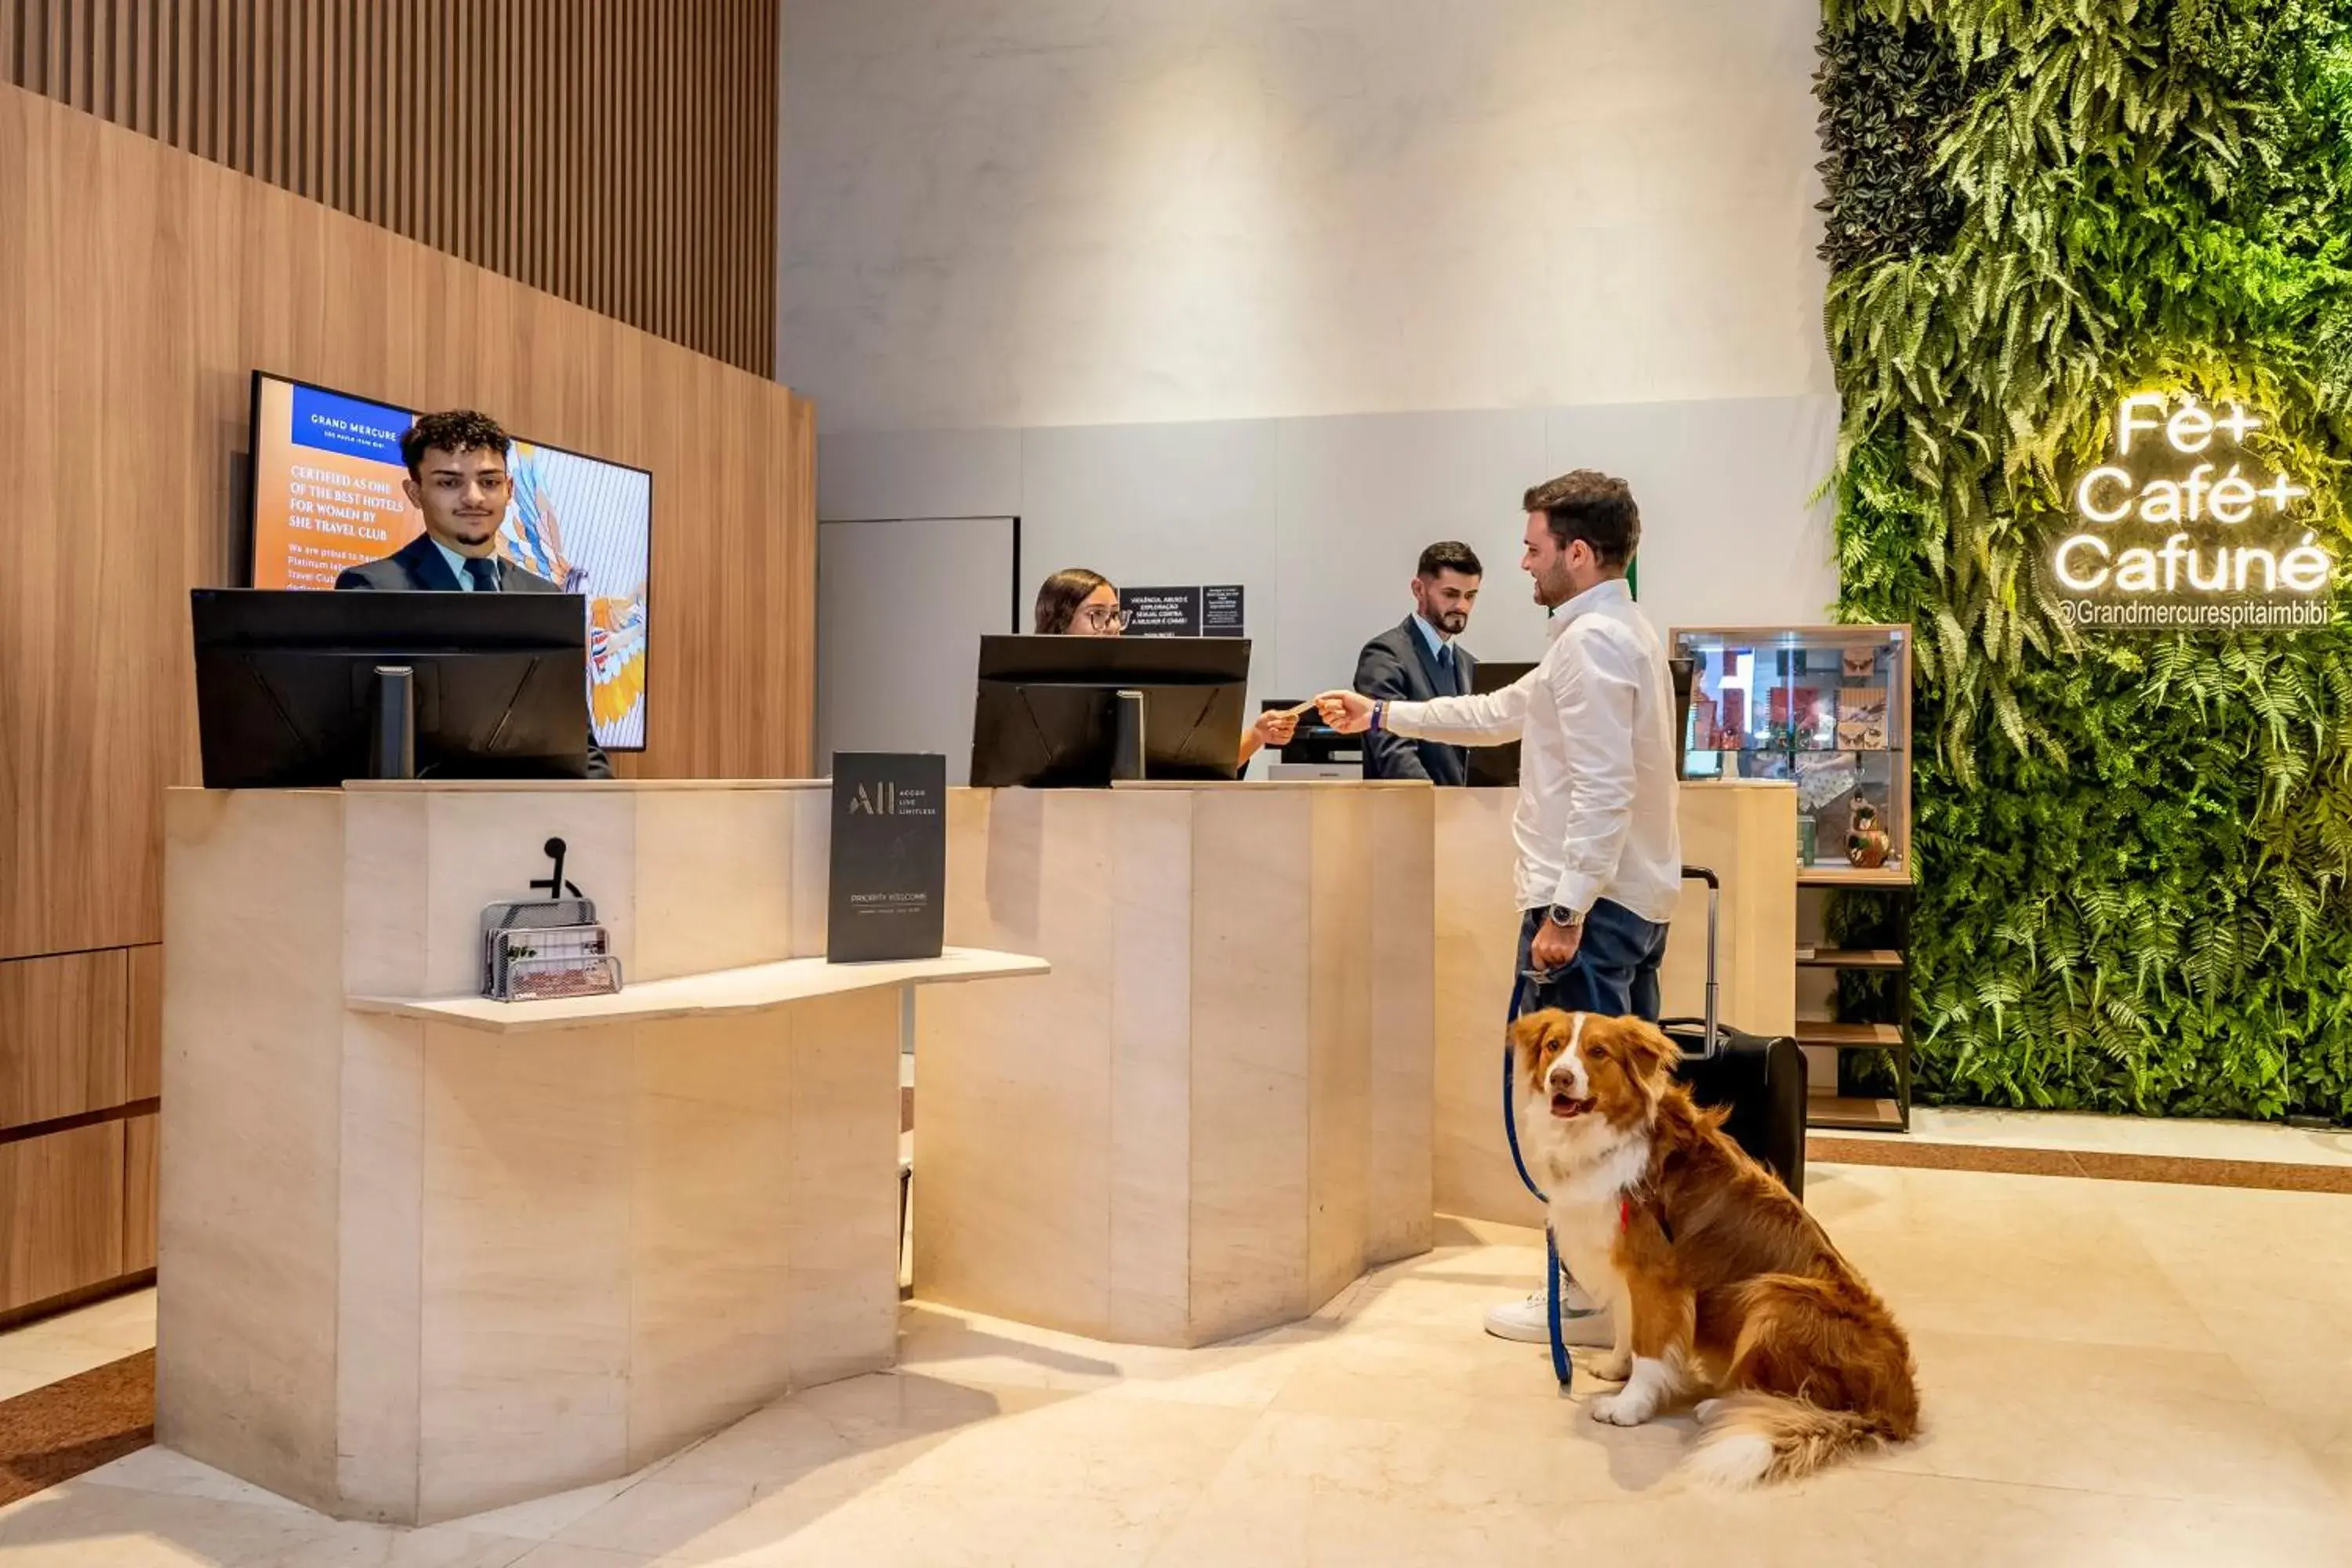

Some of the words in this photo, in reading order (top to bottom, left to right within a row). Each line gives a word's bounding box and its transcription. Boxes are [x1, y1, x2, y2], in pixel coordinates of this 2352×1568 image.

[310, 413, 347, 430] GRAND
[350, 423, 397, 441] MERCURE
[290, 465, 350, 487] CERTIFIED
[353, 477, 367, 491] AS
[368, 481, 391, 494] ONE
[2078, 463, 2310, 523] Café+
[290, 481, 307, 496] OF
[308, 485, 332, 500] THE
[334, 489, 362, 506] BEST
[363, 495, 404, 512] HOTELS
[290, 498, 314, 513] FOR
[316, 502, 361, 521] WOMEN
[363, 510, 377, 524] BY
[289, 514, 313, 529] SHE
[314, 517, 355, 537] TRAVEL
[358, 525, 387, 541] CLUB
[289, 543, 303, 554] We
[2054, 531, 2331, 592] Cafuné
[288, 556, 328, 570] Platinum
[2059, 599, 2328, 630] @Grandmercurespitaimbibi
